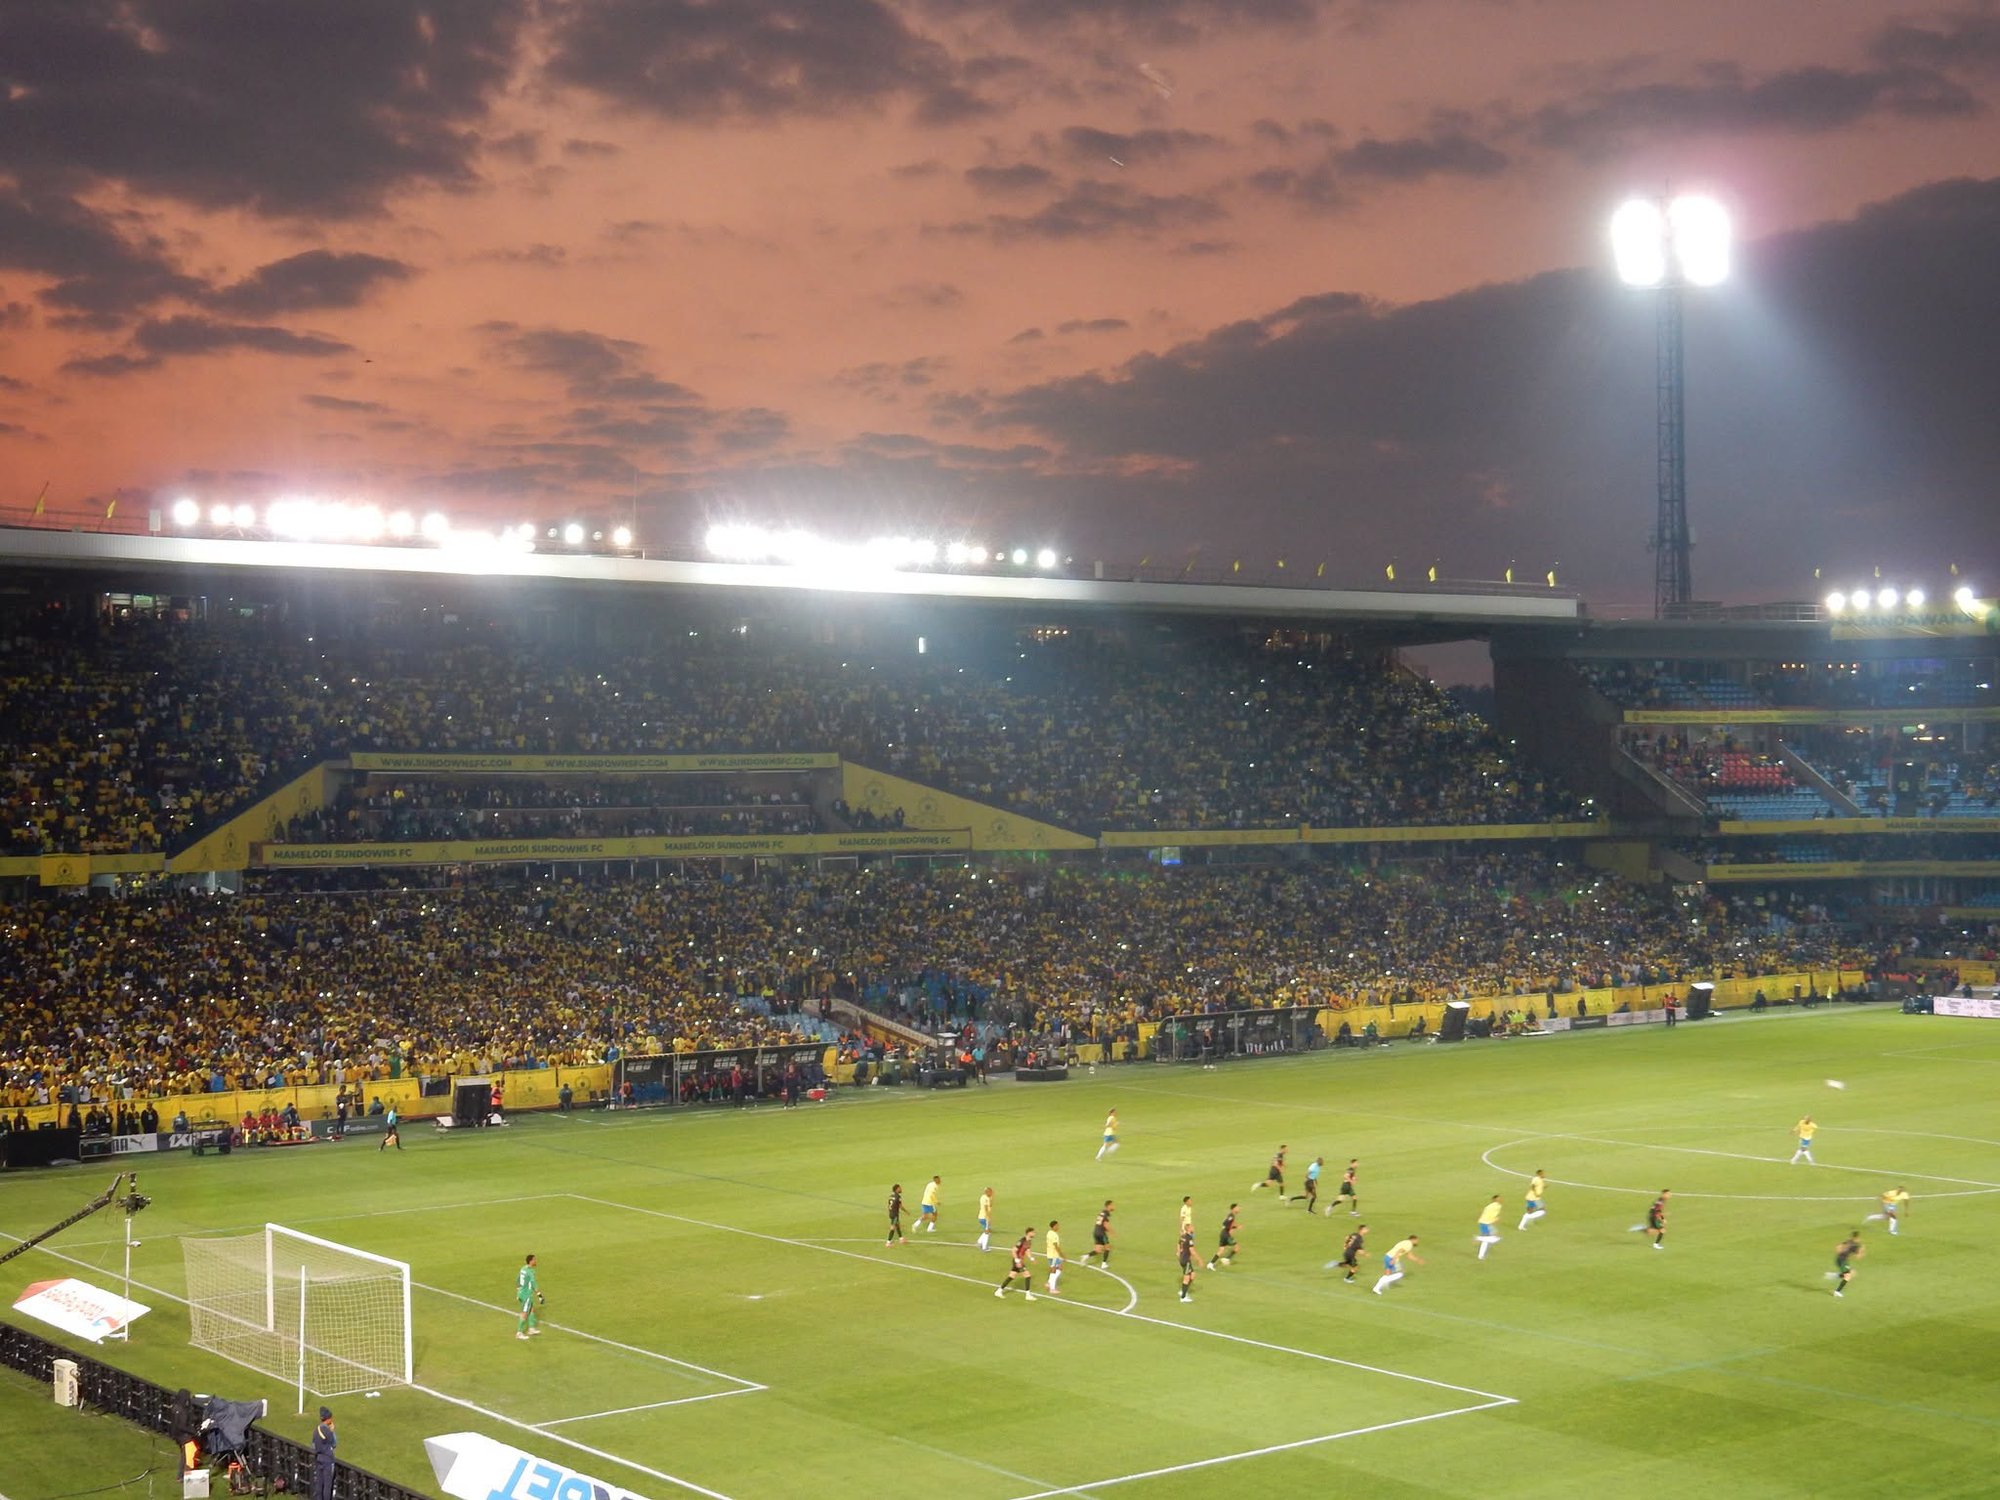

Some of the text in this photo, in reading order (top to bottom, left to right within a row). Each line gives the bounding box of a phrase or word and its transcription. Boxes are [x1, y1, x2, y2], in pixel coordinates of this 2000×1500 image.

[381, 757, 512, 768] WWW.SUNDOWNSFC.COM
[664, 840, 784, 851] MAMELODI SUNDOWNS FC
[838, 836, 951, 846] MAMELODI SUNDOWNS FC
[274, 848, 412, 860] MAMELODI SUNDOWNS FC
[475, 844, 603, 855] MAMELODI SUNDOWNS FC
